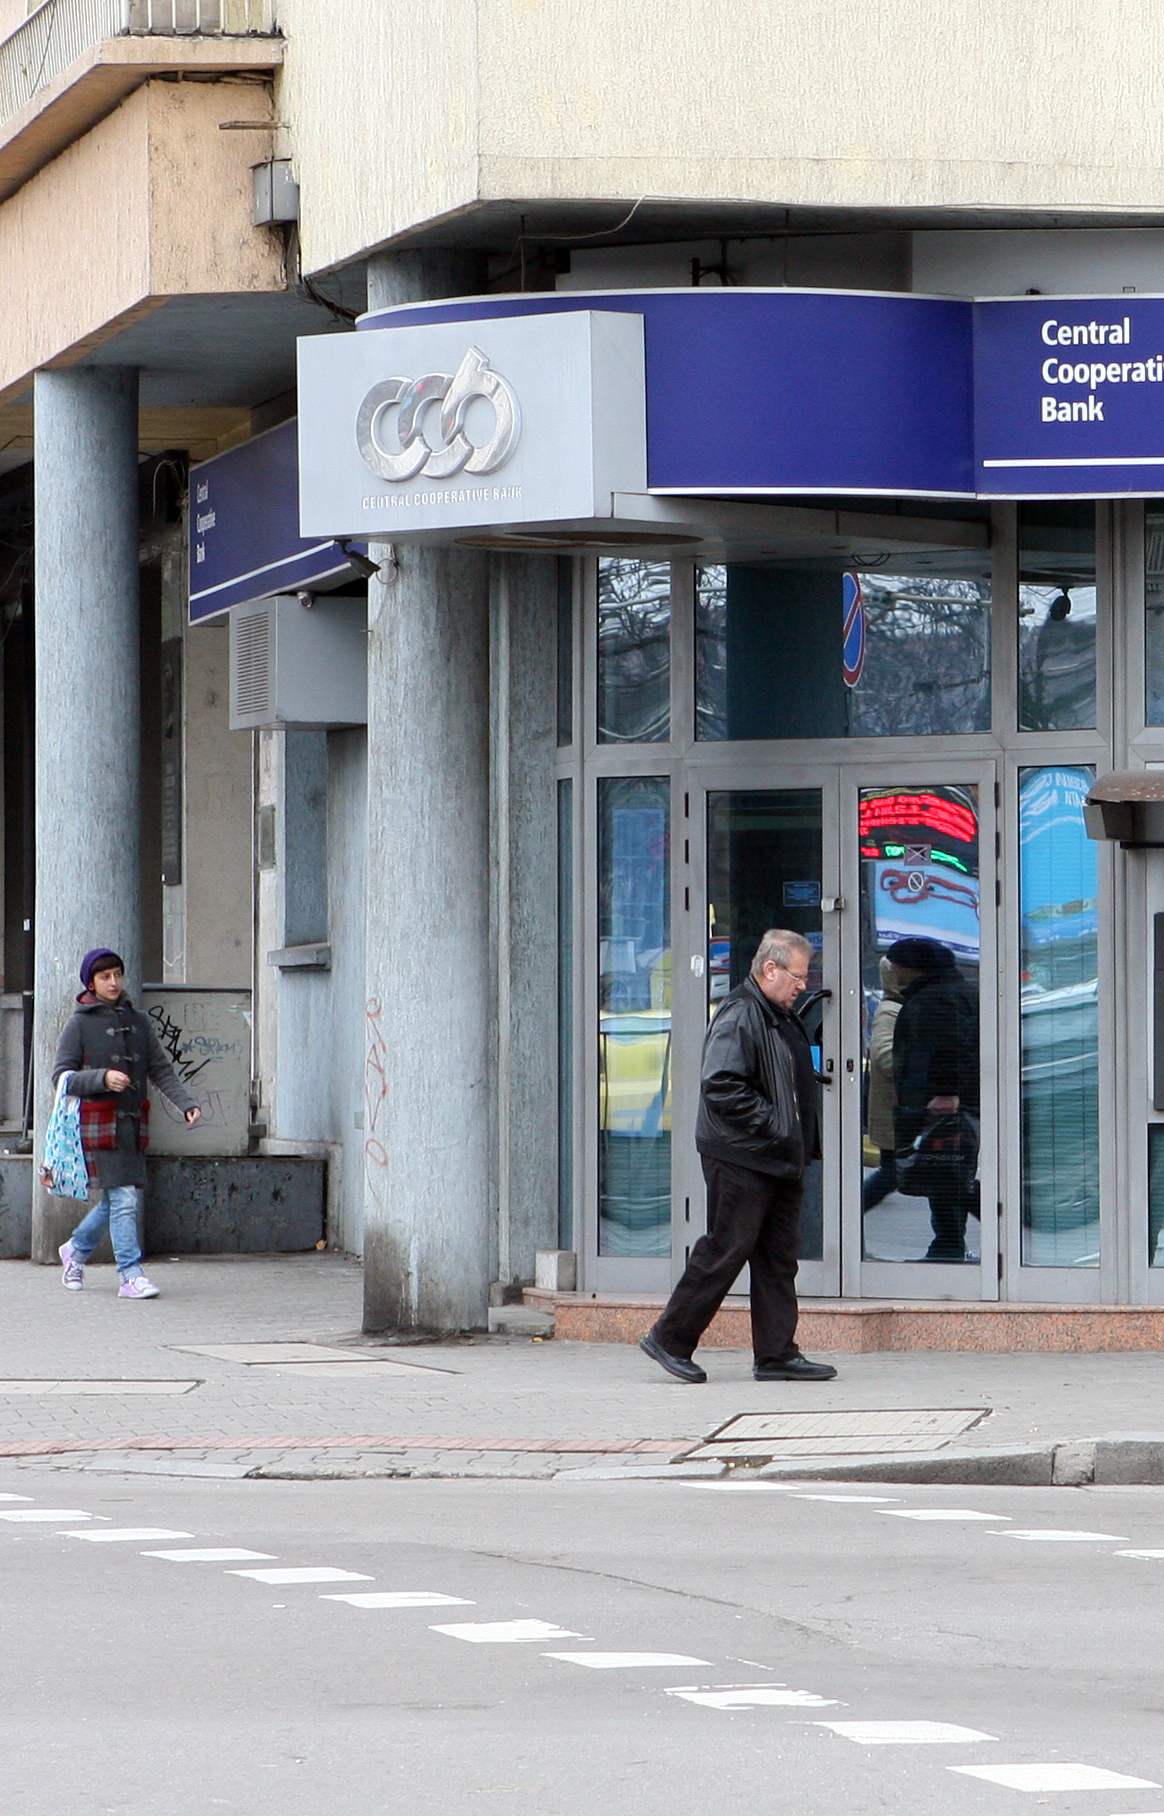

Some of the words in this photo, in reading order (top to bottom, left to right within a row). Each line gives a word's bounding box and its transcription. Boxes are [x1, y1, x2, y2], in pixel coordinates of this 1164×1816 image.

[1041, 316, 1130, 346] Central
[1041, 394, 1104, 423] Bank
[362, 494, 410, 510] CENTRAL
[413, 489, 489, 506] COOPERATIVE
[493, 486, 522, 502] BANK
